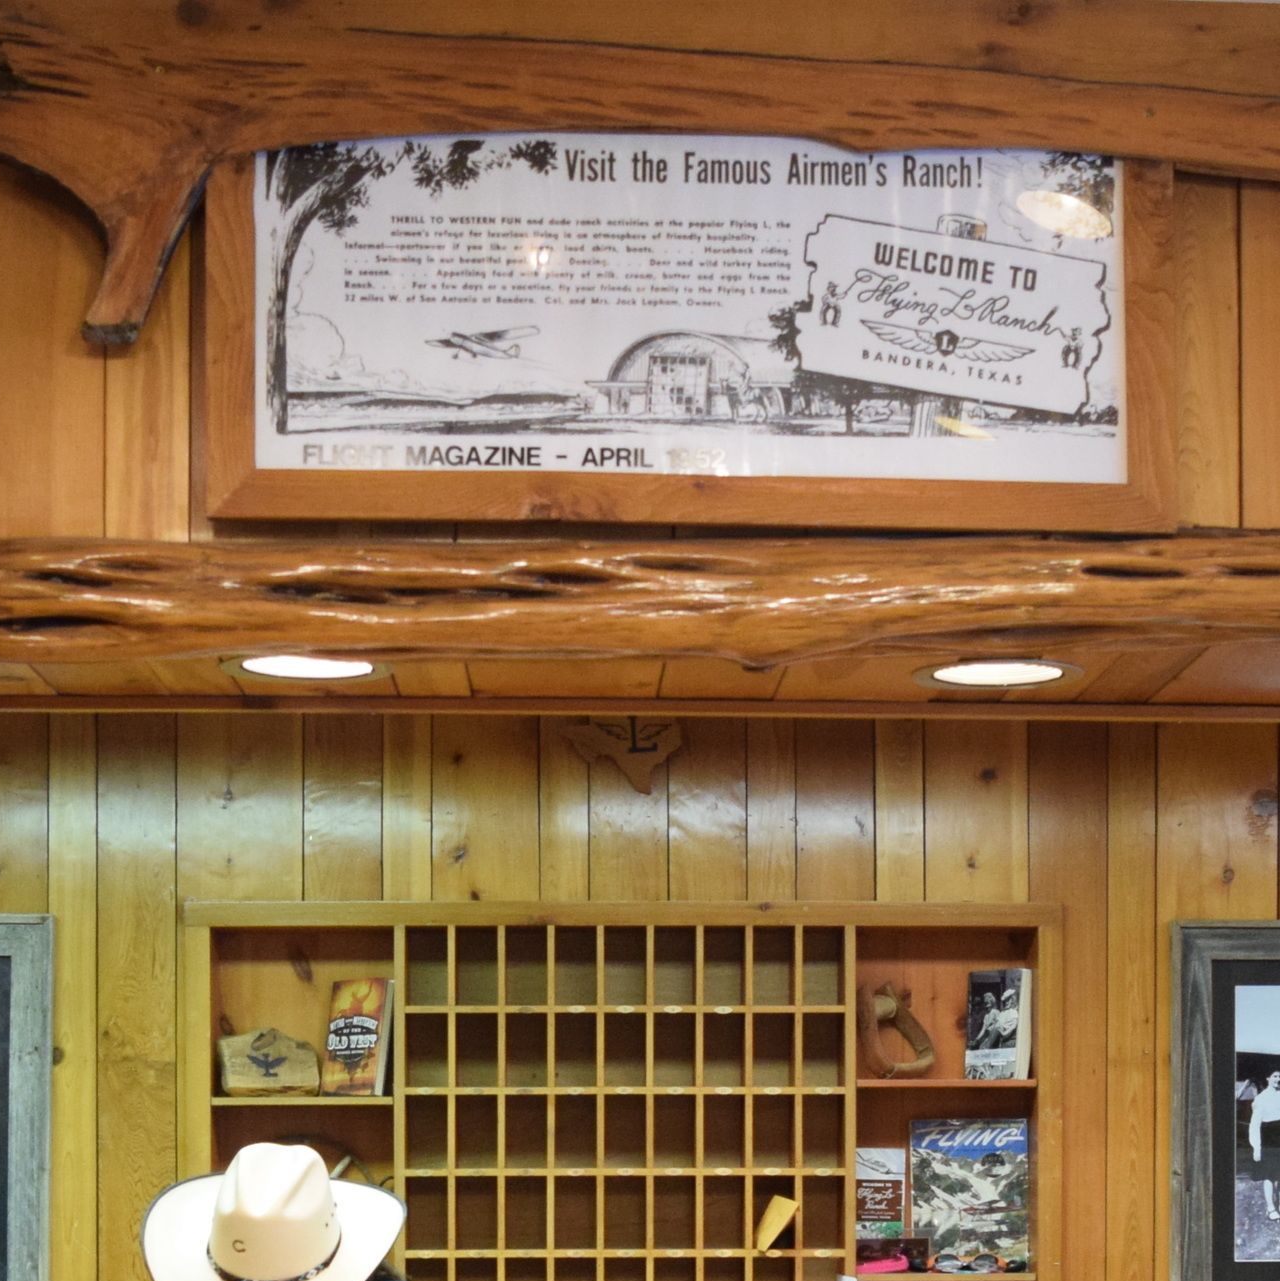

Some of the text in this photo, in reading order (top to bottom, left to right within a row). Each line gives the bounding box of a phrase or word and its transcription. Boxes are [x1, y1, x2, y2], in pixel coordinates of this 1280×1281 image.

[564, 149, 983, 189] Visit the Famous Airmen's Ranch!
[391, 216, 425, 224] THRILL
[430, 216, 444, 224] TO
[449, 216, 496, 224] WESTERN
[874, 242, 1037, 292] WELCOME TO
[855, 268, 940, 325] Flying
[978, 295, 1060, 336] Ranch
[862, 349, 1023, 386] BANDERA, TEXAS
[303, 444, 394, 466] FLIGHT
[404, 445, 541, 467] MAGAZINE
[582, 446, 654, 468] APRIL
[921, 1128, 1024, 1148] FLYING
